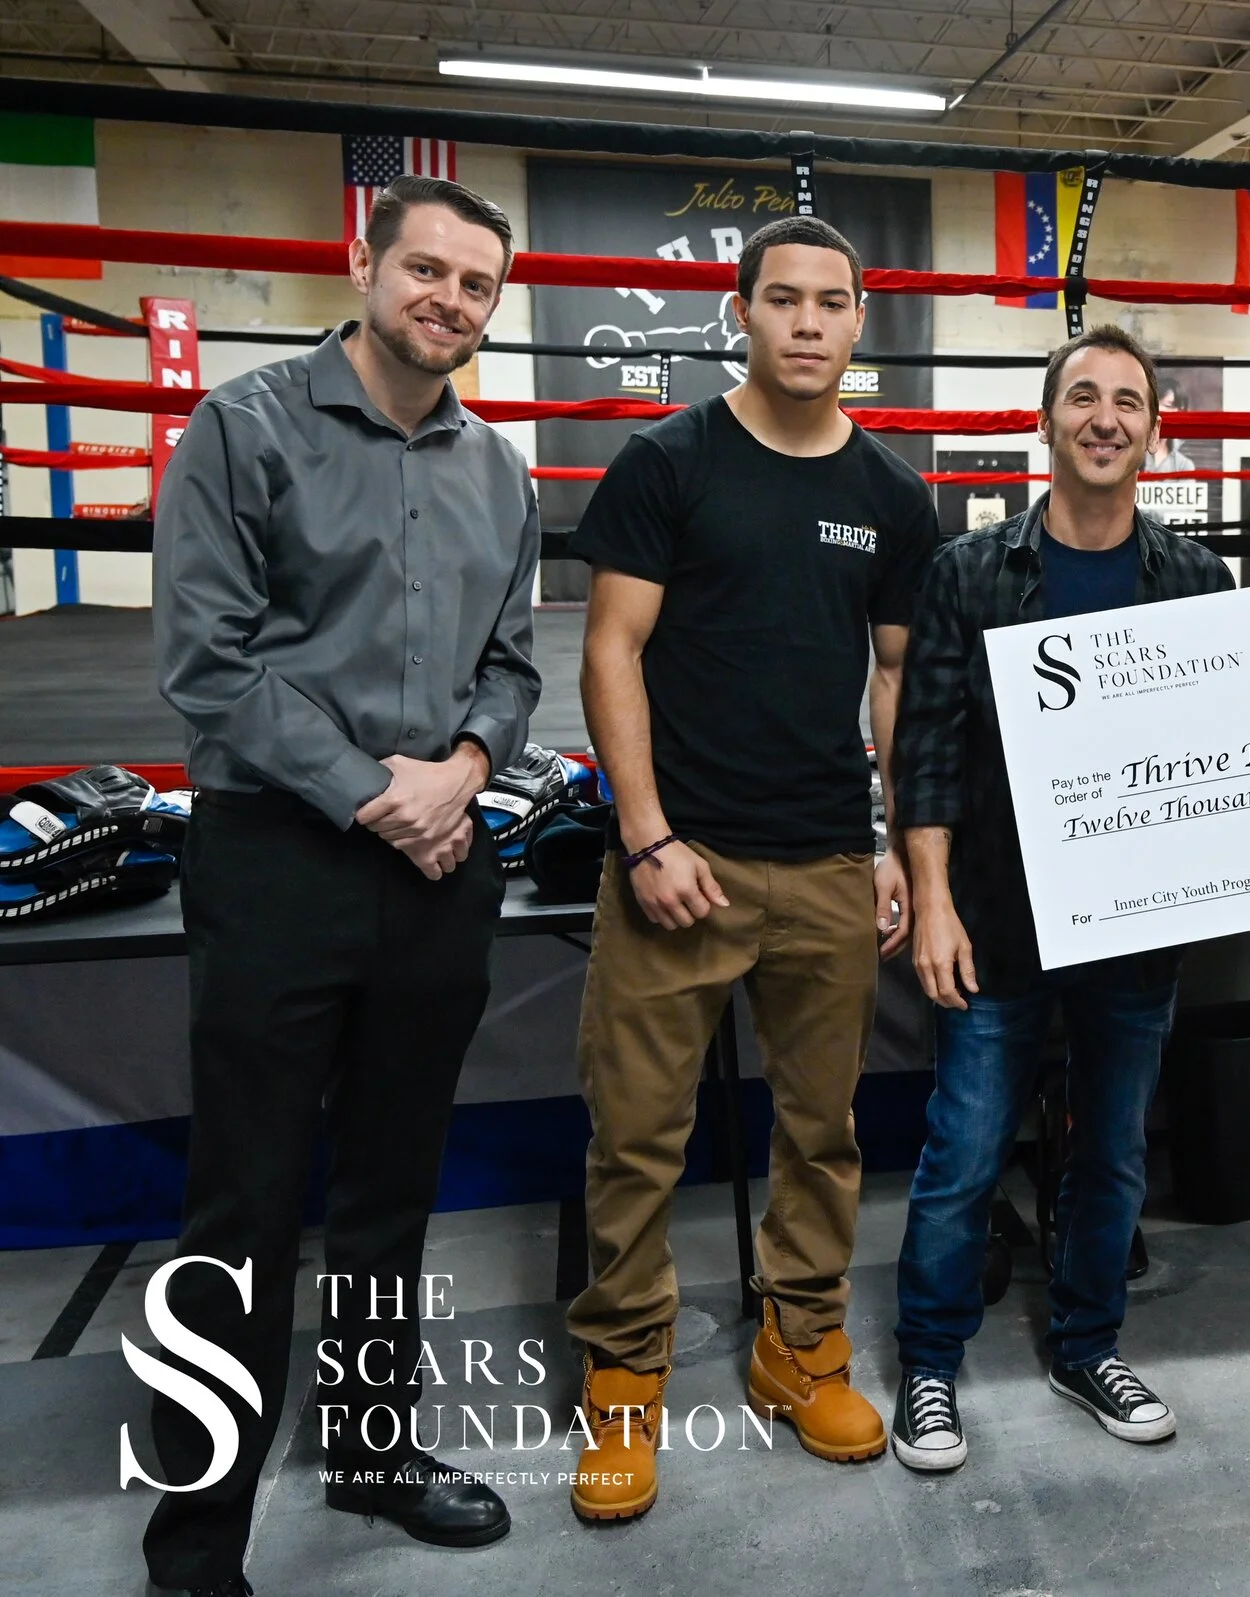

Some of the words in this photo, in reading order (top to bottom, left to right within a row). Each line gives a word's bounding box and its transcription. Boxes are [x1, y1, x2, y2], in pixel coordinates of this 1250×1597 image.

[664, 178, 745, 217] Julio
[1070, 178, 1099, 276] RINGSIDE
[621, 365, 660, 387] EST
[818, 521, 876, 548] THRIVE
[1090, 628, 1136, 648] THE
[1094, 644, 1168, 670] SCARS
[1137, 684, 1175, 695] IMPERFECTLY
[1175, 680, 1200, 689] PERFECT
[1052, 777, 1075, 790] Pay
[1077, 774, 1089, 785] to
[1092, 771, 1112, 782] the
[1121, 750, 1231, 788] Thrive
[1055, 792, 1089, 806] Order
[1092, 787, 1104, 798] of
[1063, 807, 1151, 838] Twelve
[1114, 895, 1150, 912] Inner
[1152, 890, 1179, 905] City
[1182, 882, 1219, 899] Youth
[1071, 914, 1093, 925] For
